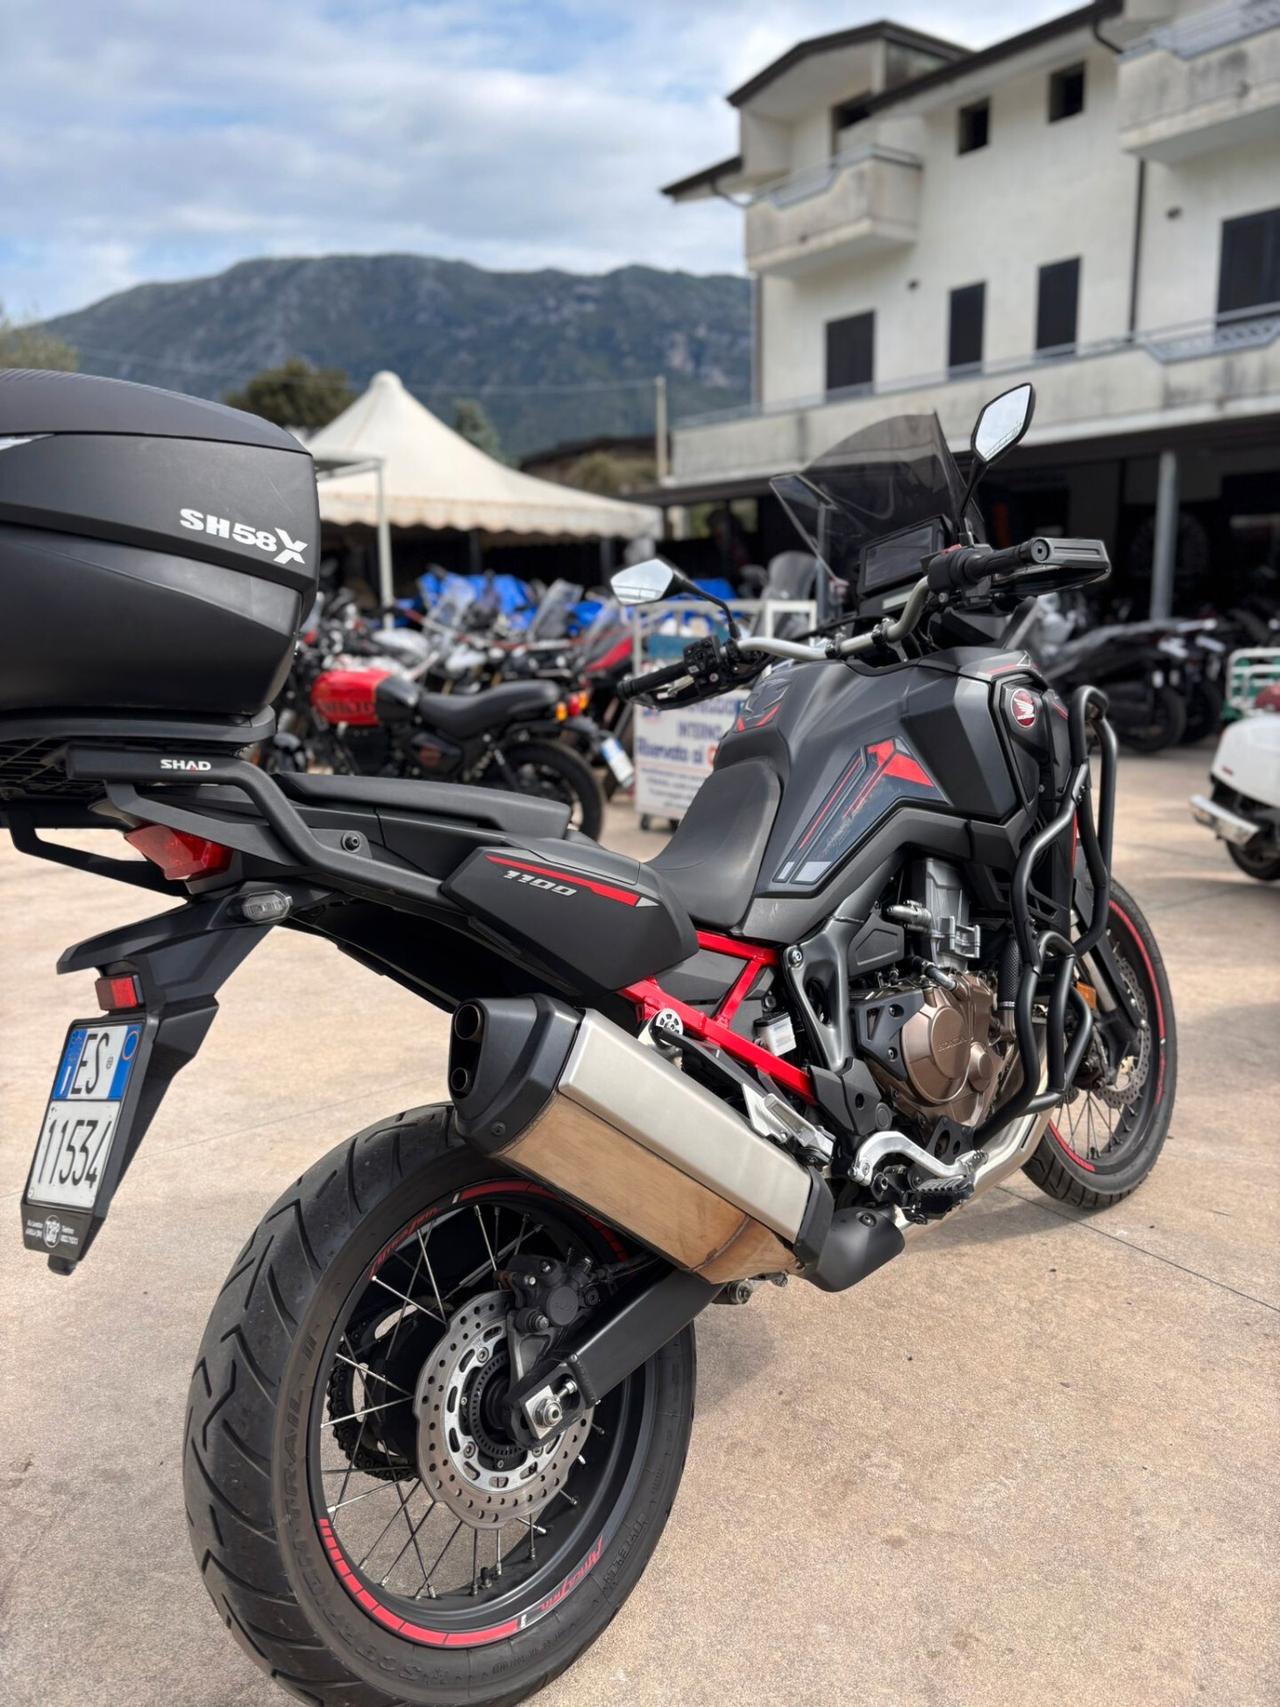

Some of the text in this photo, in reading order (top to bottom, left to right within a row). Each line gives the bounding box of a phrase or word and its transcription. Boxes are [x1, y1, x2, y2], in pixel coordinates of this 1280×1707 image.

[179, 508, 308, 564] SH58X
[160, 758, 212, 771] SHAD
[503, 870, 577, 896] 1100
[70, 1032, 110, 1095] ES
[38, 1119, 112, 1189] 11534
